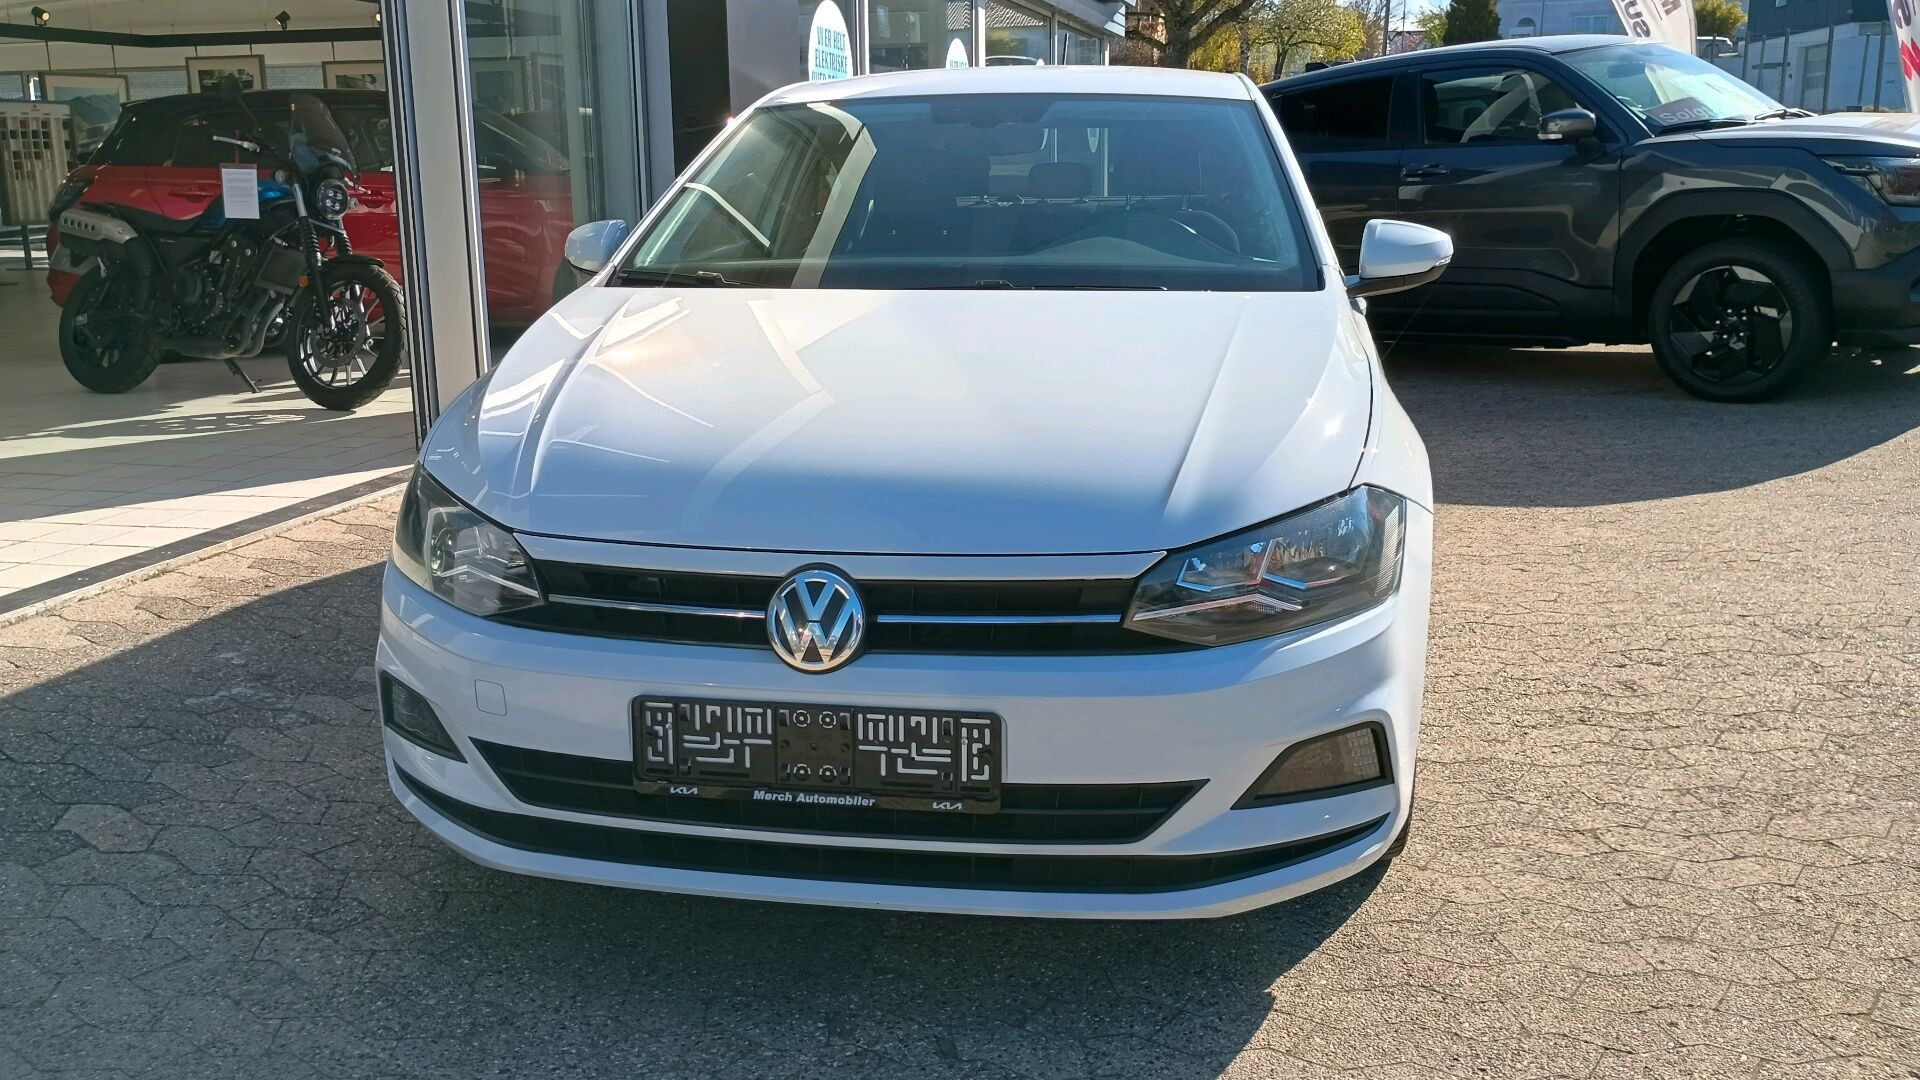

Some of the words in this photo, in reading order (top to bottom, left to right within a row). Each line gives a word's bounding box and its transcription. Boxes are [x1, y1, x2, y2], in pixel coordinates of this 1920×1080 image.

[814, 48, 848, 74] ELEKTRISKE
[670, 786, 698, 795] KIA
[753, 790, 793, 803] Mørch
[796, 793, 876, 807] Automobiler
[932, 801, 963, 810] KIA
